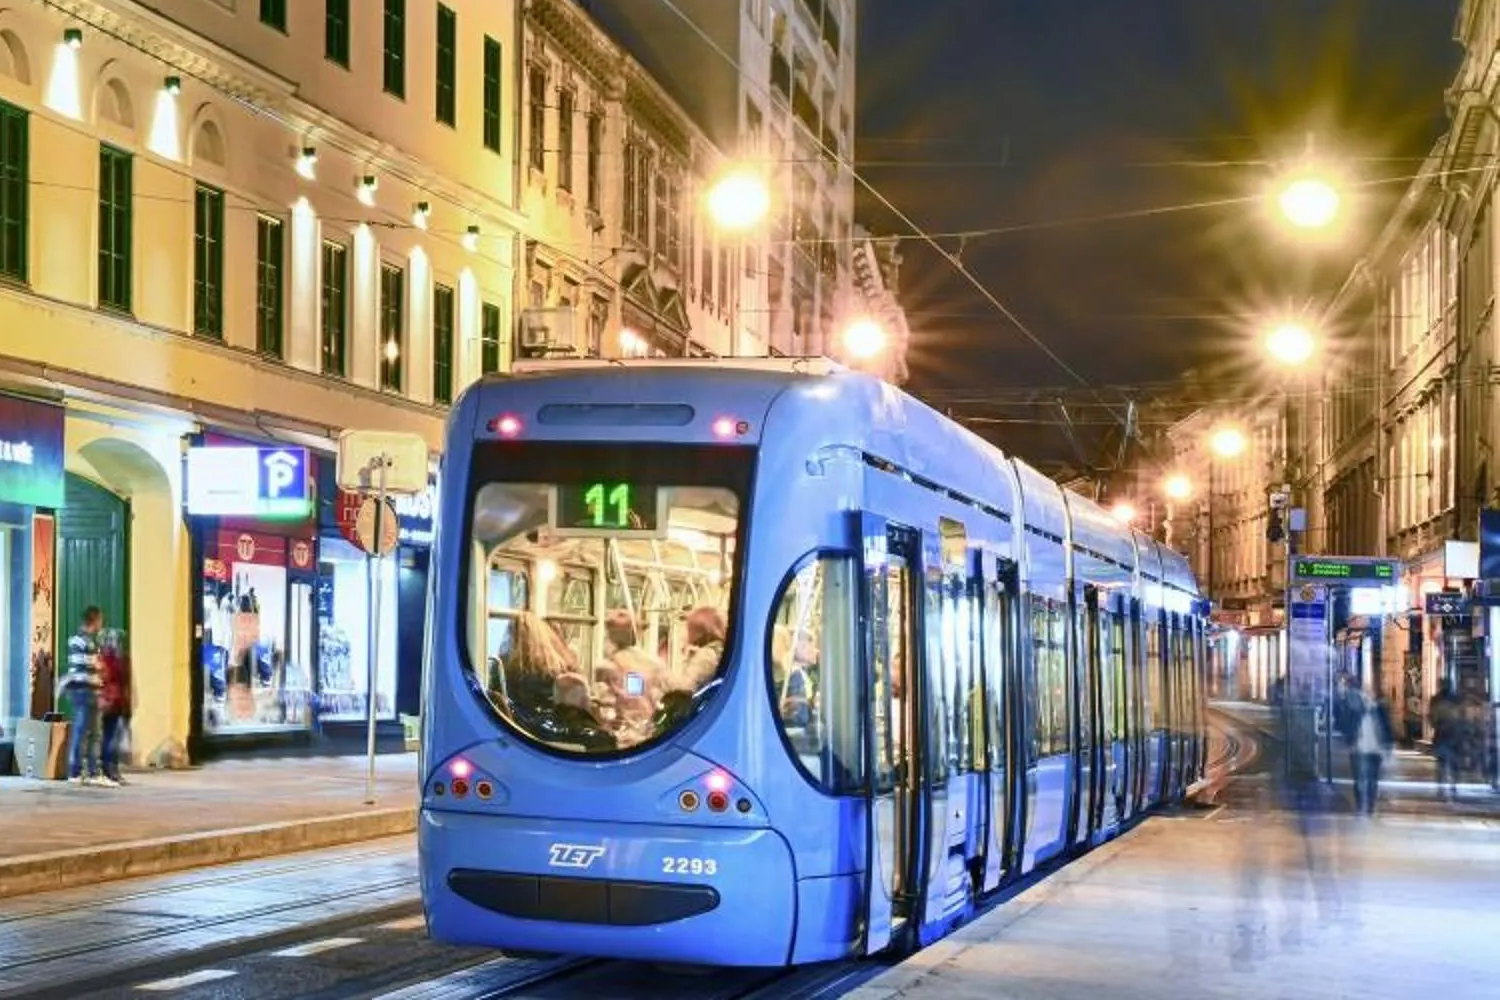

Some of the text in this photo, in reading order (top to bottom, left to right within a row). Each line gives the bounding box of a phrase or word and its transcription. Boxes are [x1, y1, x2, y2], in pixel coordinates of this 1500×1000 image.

[585, 483, 629, 526] 11
[549, 843, 606, 869] ZET
[662, 857, 717, 875] 2293
